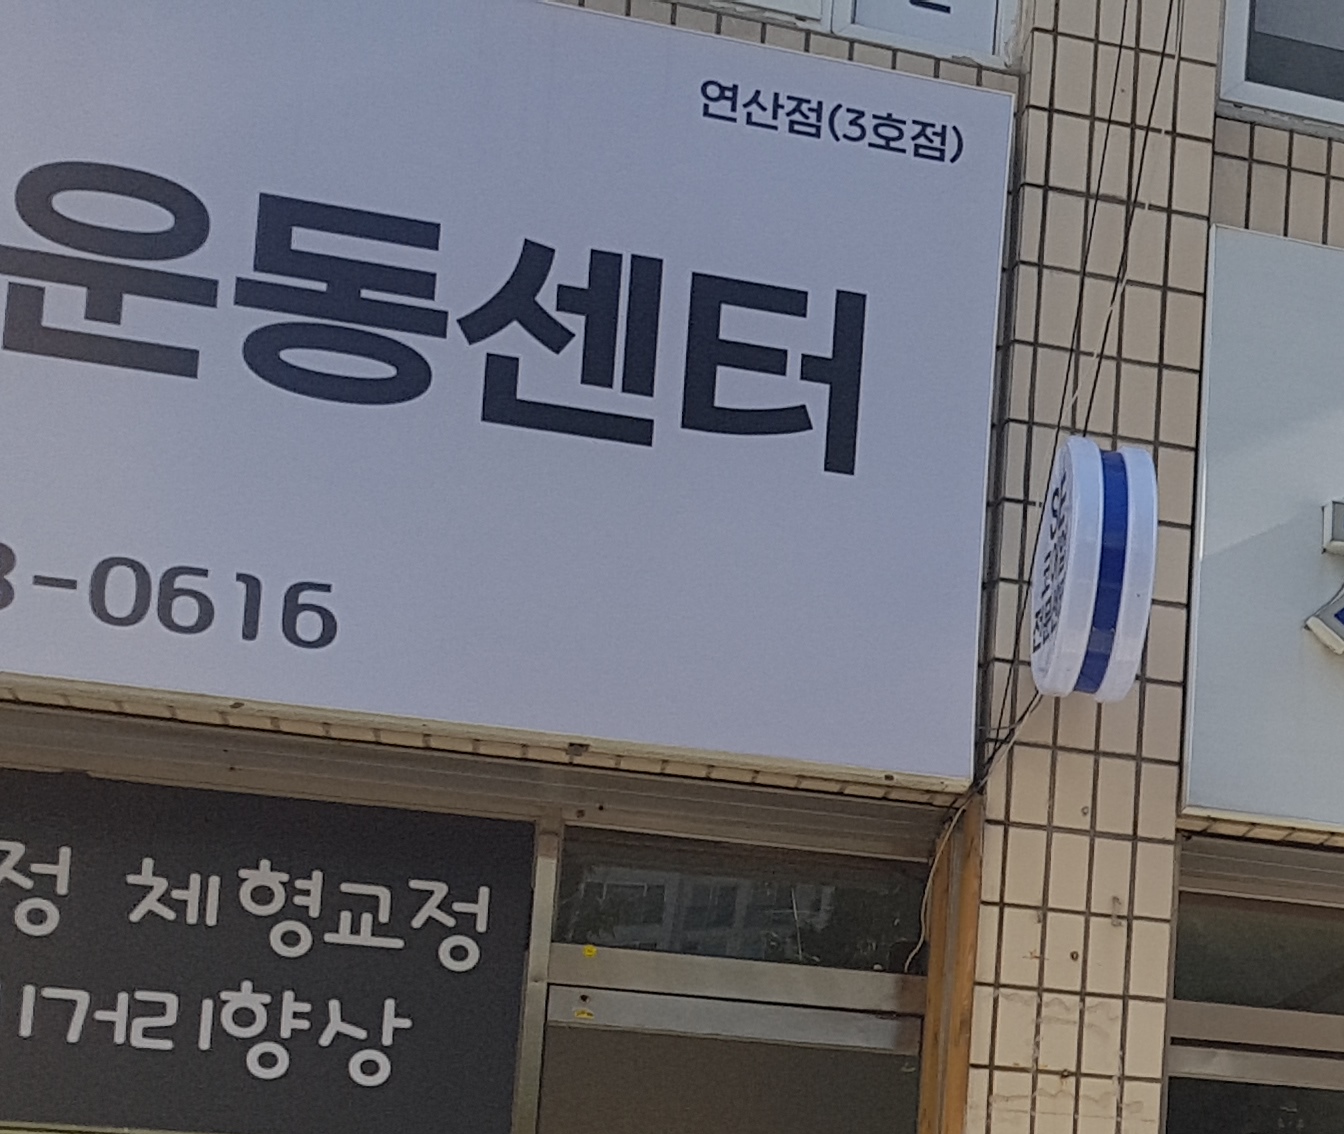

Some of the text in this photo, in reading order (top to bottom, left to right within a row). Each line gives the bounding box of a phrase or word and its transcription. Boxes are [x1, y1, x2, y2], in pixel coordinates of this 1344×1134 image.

[698, 79, 965, 166] 연산점(3호점)
[0, 160, 867, 475] 운동센터
[123, 855, 492, 973] 체형교정
